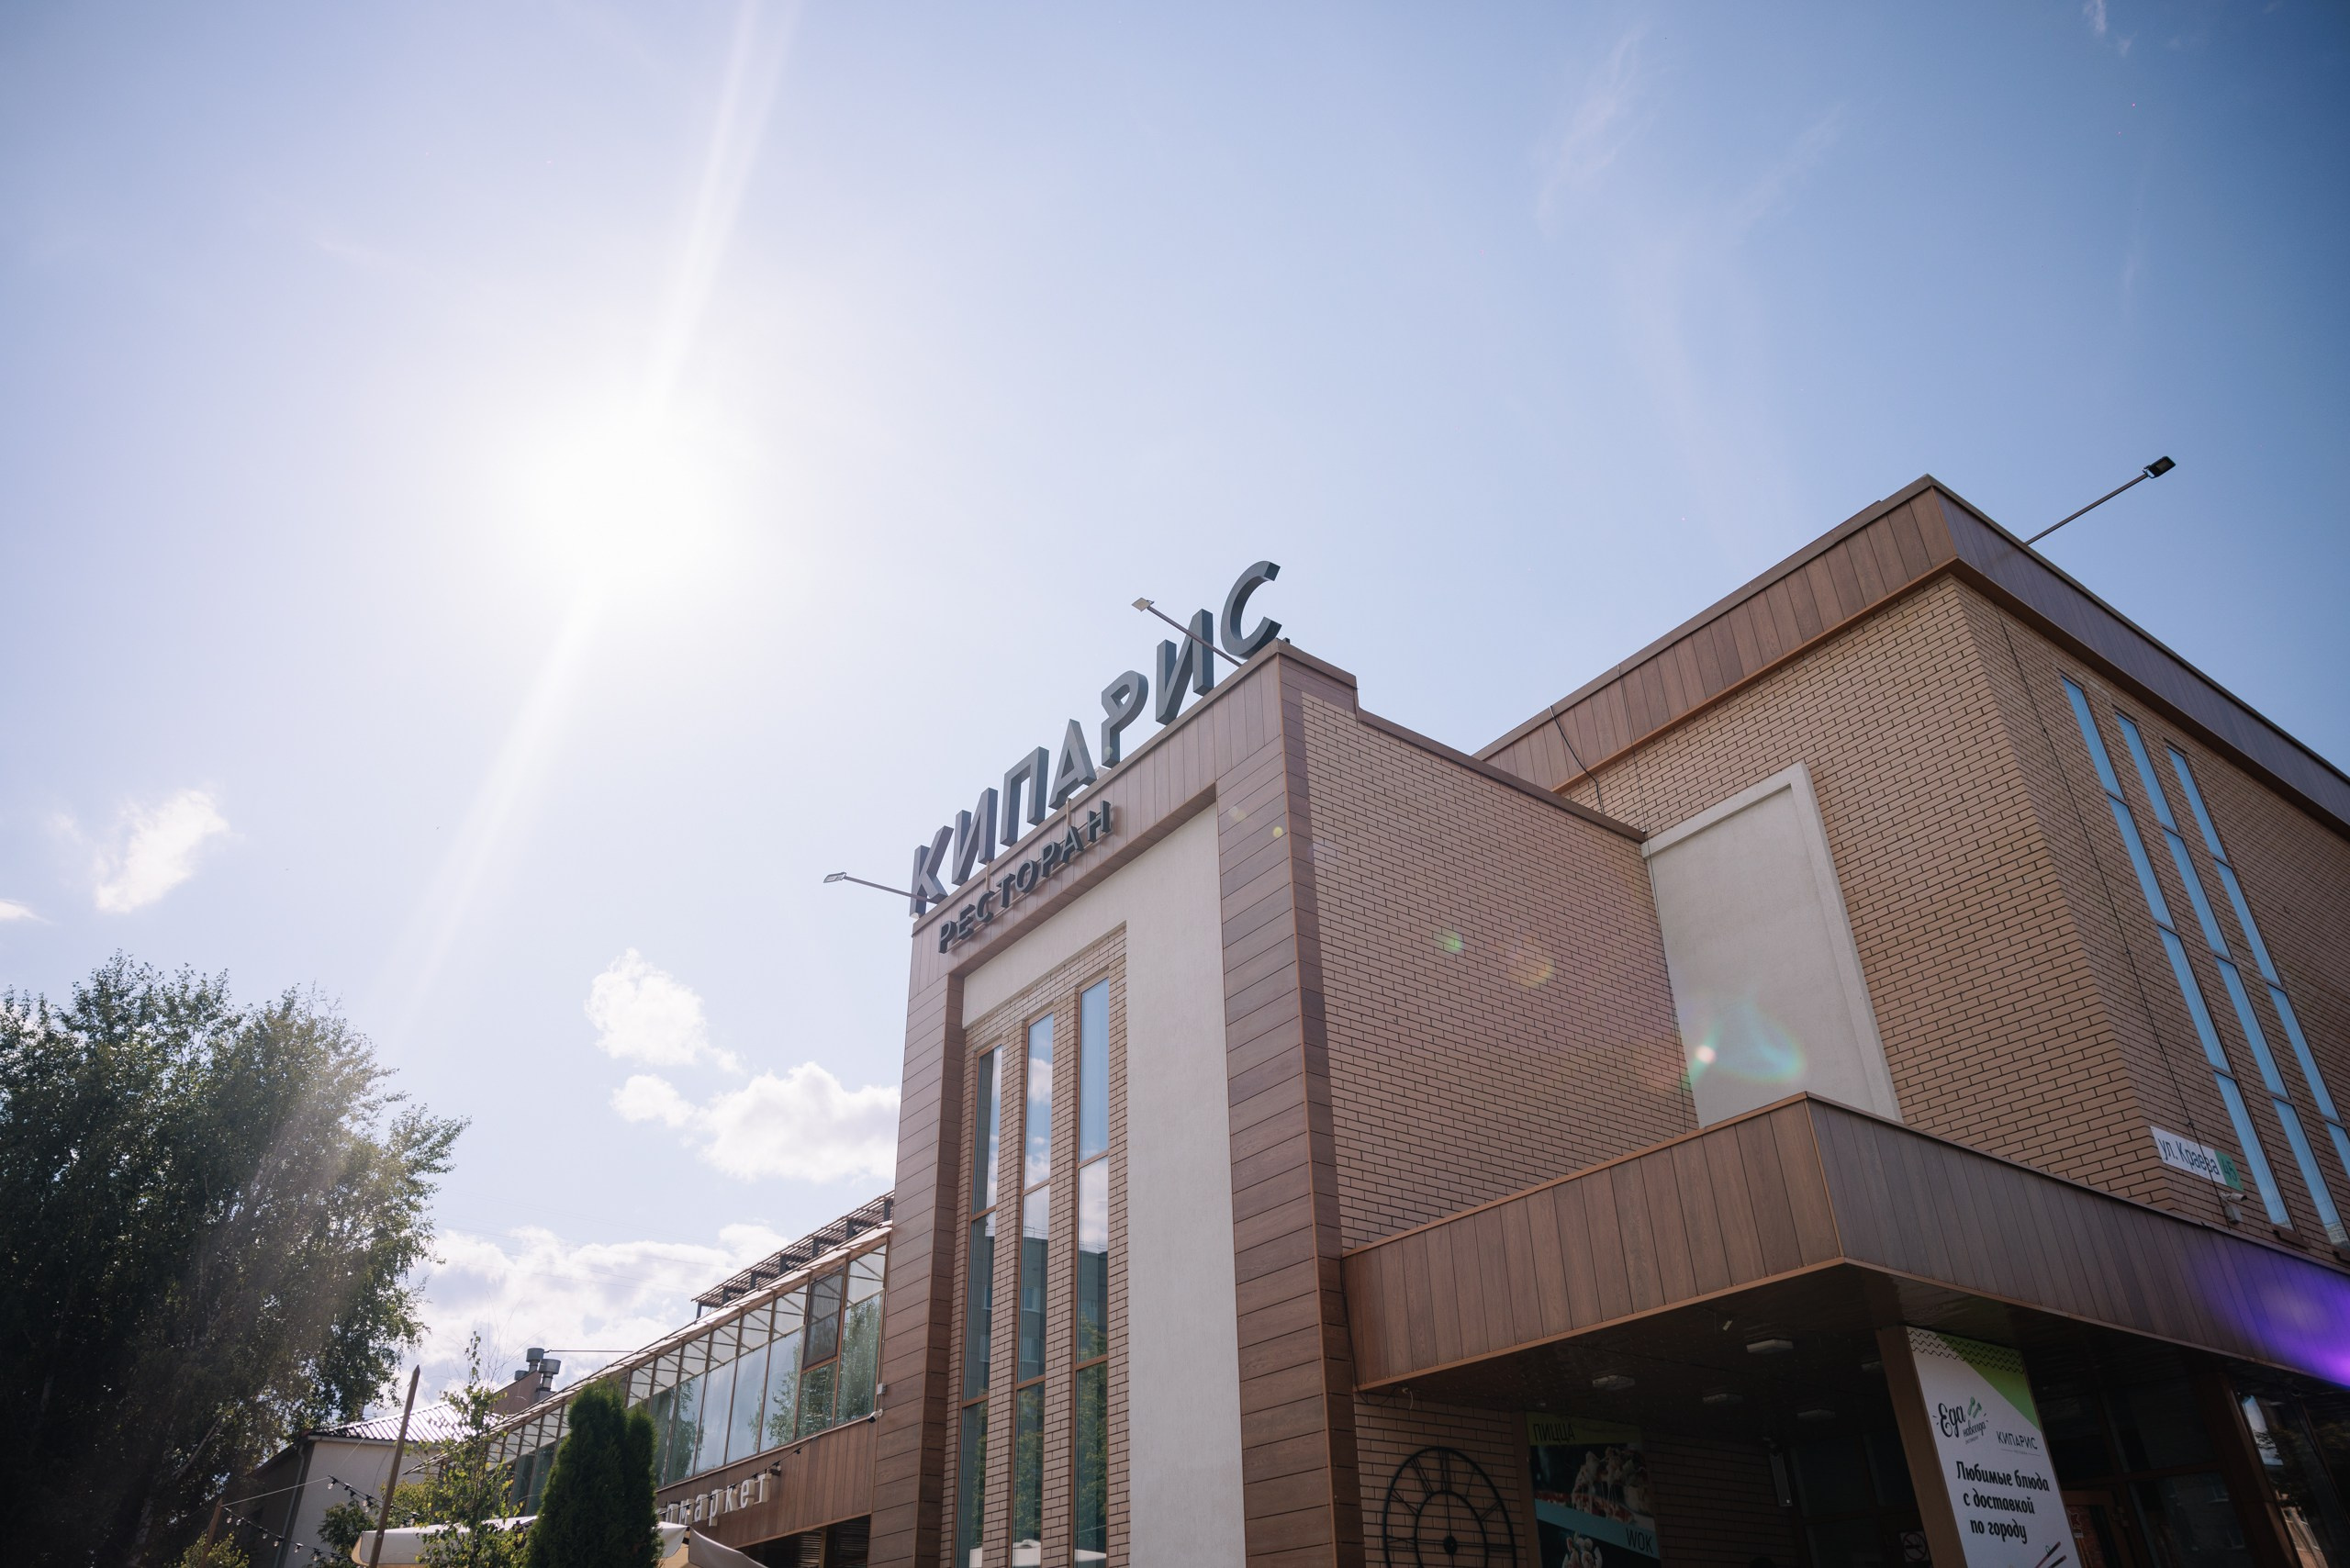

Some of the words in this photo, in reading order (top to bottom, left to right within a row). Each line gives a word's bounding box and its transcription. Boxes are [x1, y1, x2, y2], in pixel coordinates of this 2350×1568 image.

[910, 561, 1281, 918] КИПАРИС
[938, 801, 1112, 954] РЕСТОРАН
[2158, 1138, 2178, 1160] ул.
[2176, 1141, 2220, 1175] Краева
[2221, 1159, 2238, 1182] 45
[1533, 1423, 1575, 1443] ПИЦЦА
[1997, 1431, 2038, 1450] КИПАРИС
[1956, 1461, 2012, 1487] Любимые
[2014, 1469, 2050, 1492] блюда
[1963, 1493, 1971, 1506] с
[1973, 1488, 2035, 1515] доставкой
[1626, 1529, 1653, 1553] WOK
[1970, 1518, 1985, 1534] по
[1988, 1518, 2028, 1544] городу
